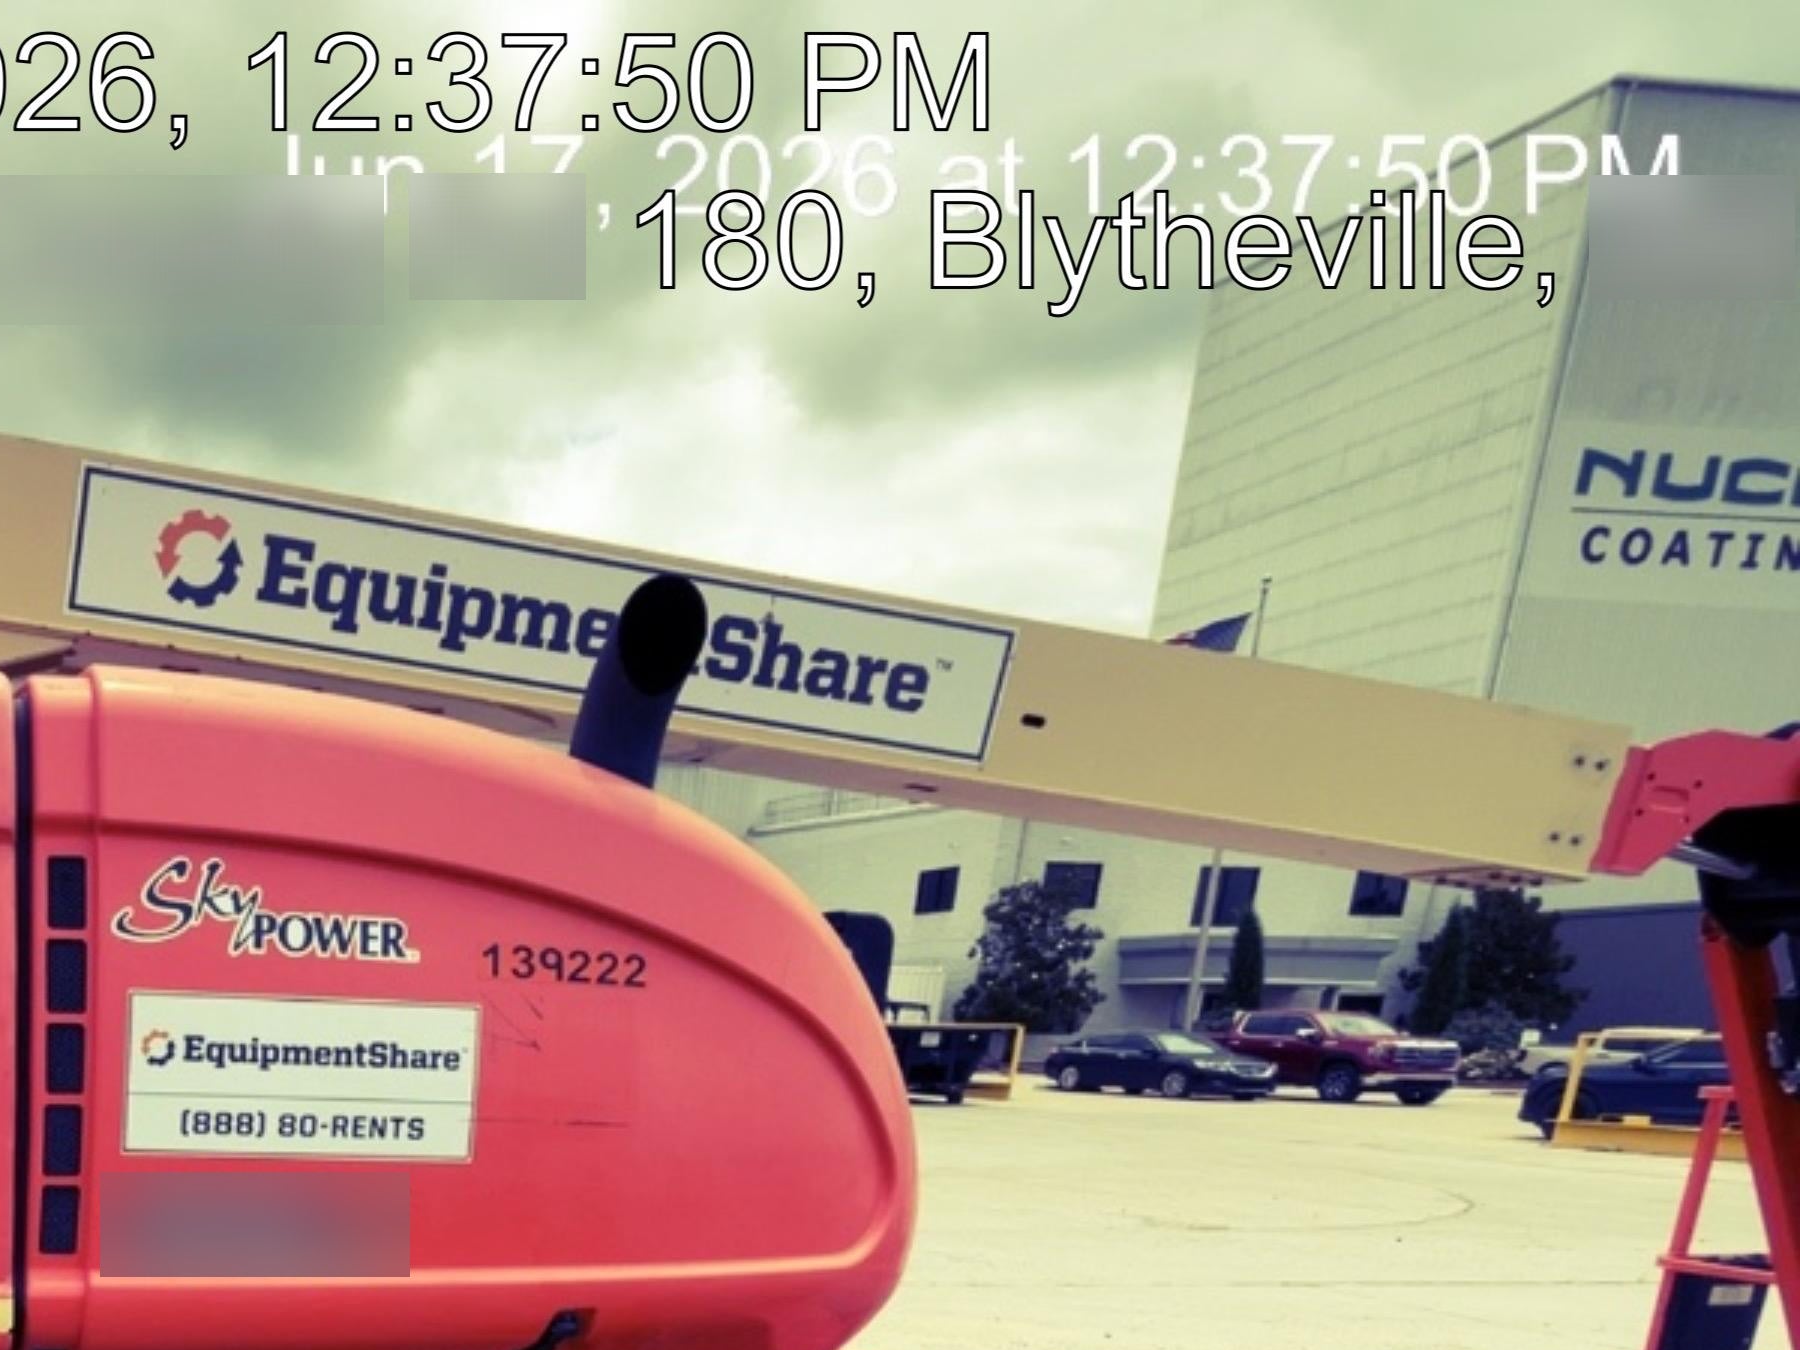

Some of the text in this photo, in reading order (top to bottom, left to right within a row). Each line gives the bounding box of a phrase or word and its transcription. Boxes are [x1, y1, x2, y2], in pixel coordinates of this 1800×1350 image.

[1574, 447, 1800, 507] NUC
[255, 533, 931, 714] EquipmeShare
[250, 912, 407, 959] POWER
[481, 942, 648, 988] 139222
[182, 1034, 461, 1072] EquipmentShare
[179, 1109, 425, 1141] (888) 80-RENTS
